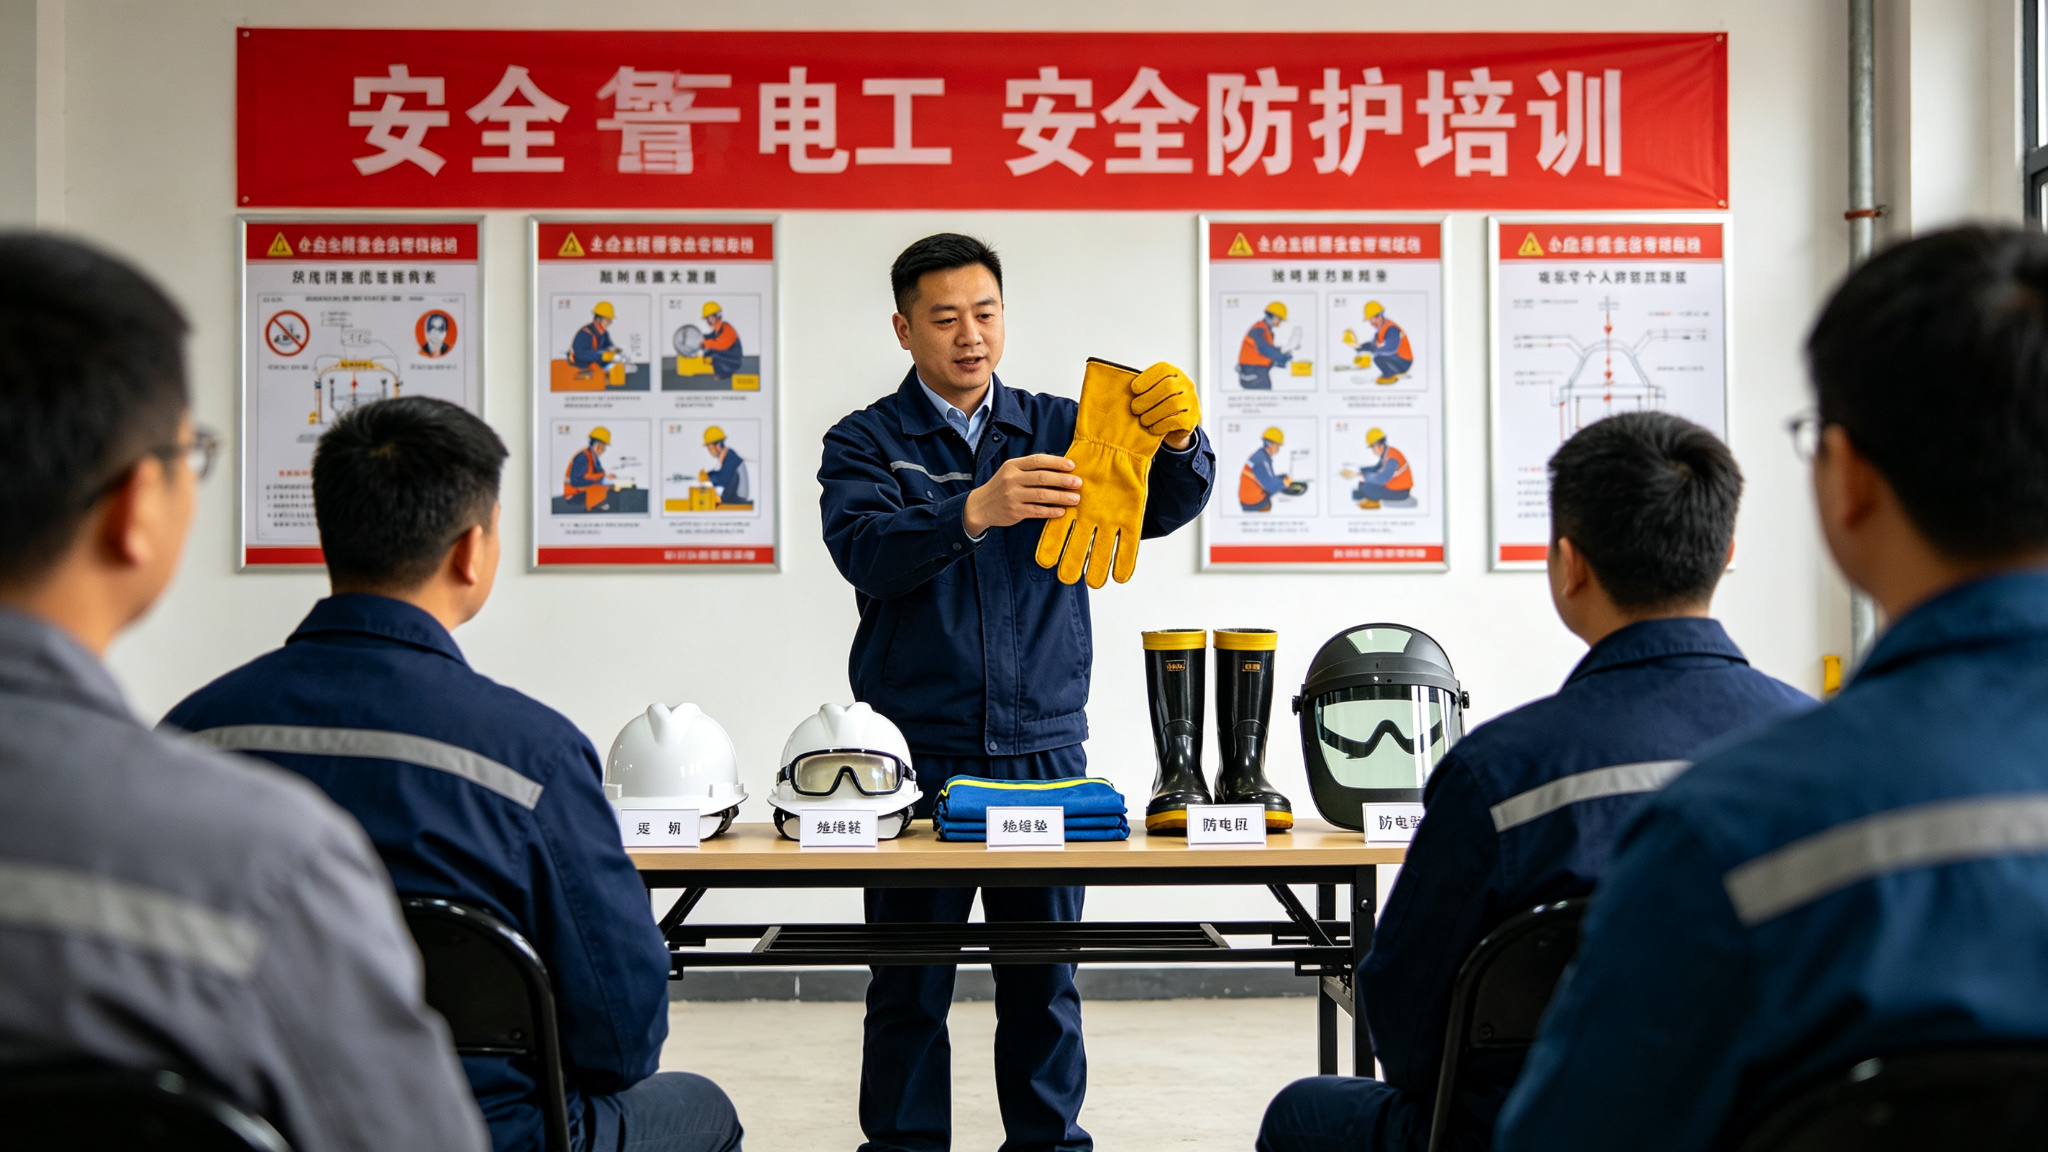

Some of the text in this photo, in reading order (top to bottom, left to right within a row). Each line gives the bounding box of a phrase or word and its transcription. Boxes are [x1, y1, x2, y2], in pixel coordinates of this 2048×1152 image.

[1002, 66, 1622, 177] 安全防护培训
